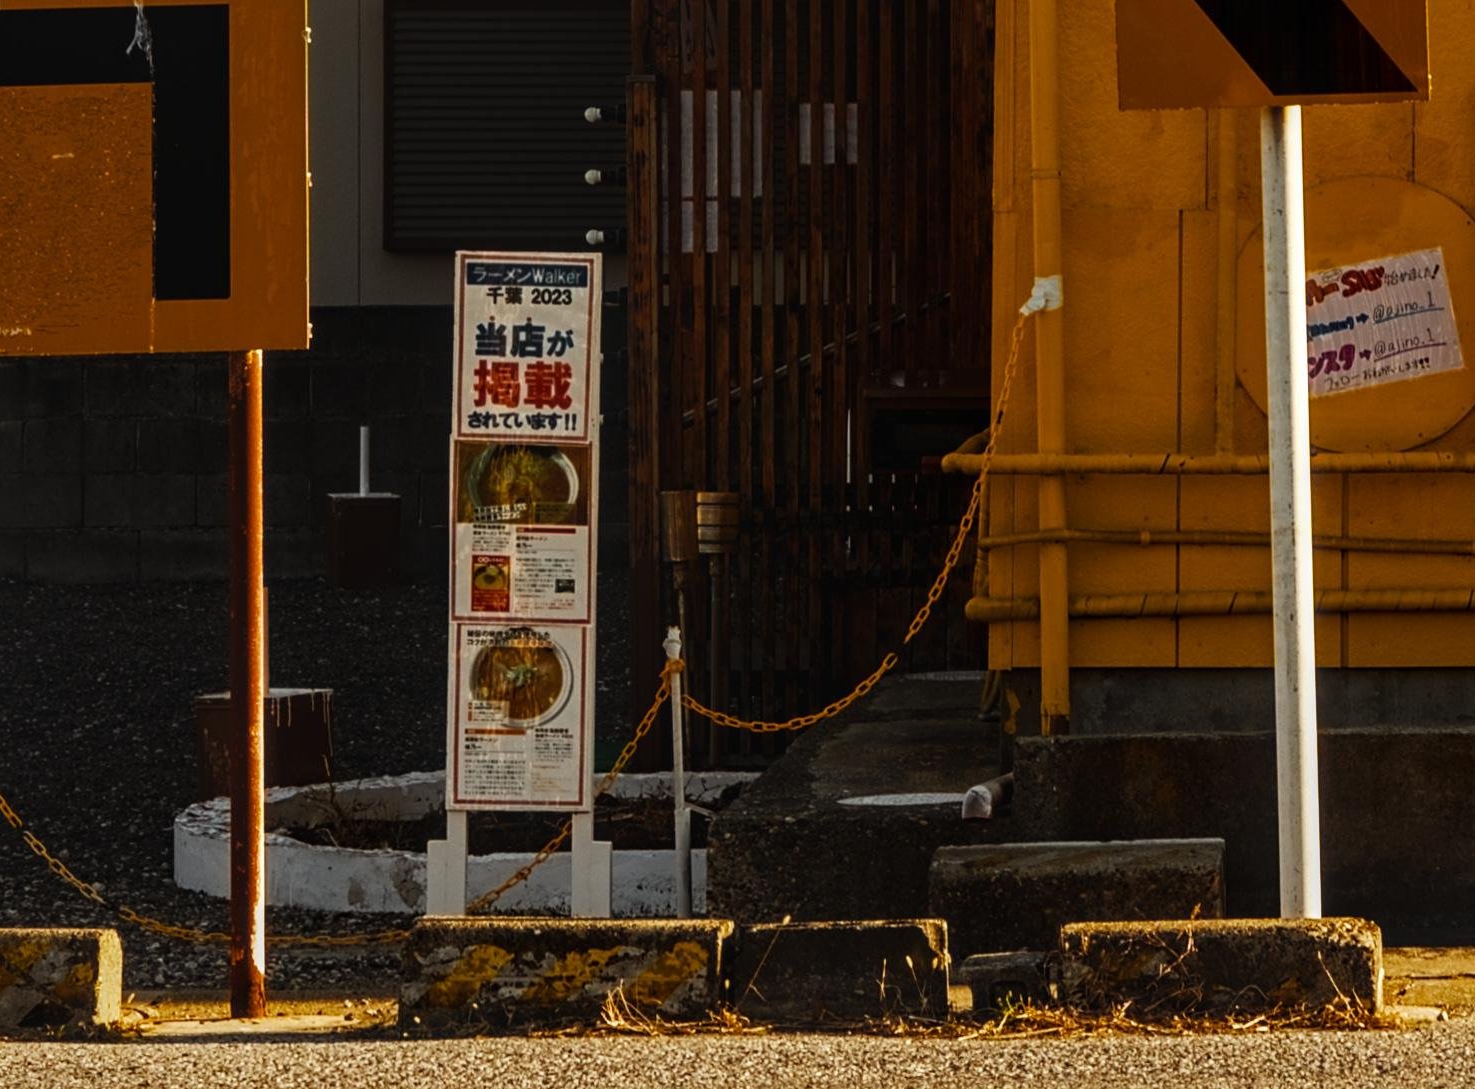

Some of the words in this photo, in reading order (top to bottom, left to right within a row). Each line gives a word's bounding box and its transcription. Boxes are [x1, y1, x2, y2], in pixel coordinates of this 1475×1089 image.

[473, 266, 582, 285] ラーメンWalker
[487, 287, 523, 305] 千葉
[531, 288, 573, 306] 2023
[475, 322, 574, 358] 当店が
[473, 360, 573, 409] 掲載
